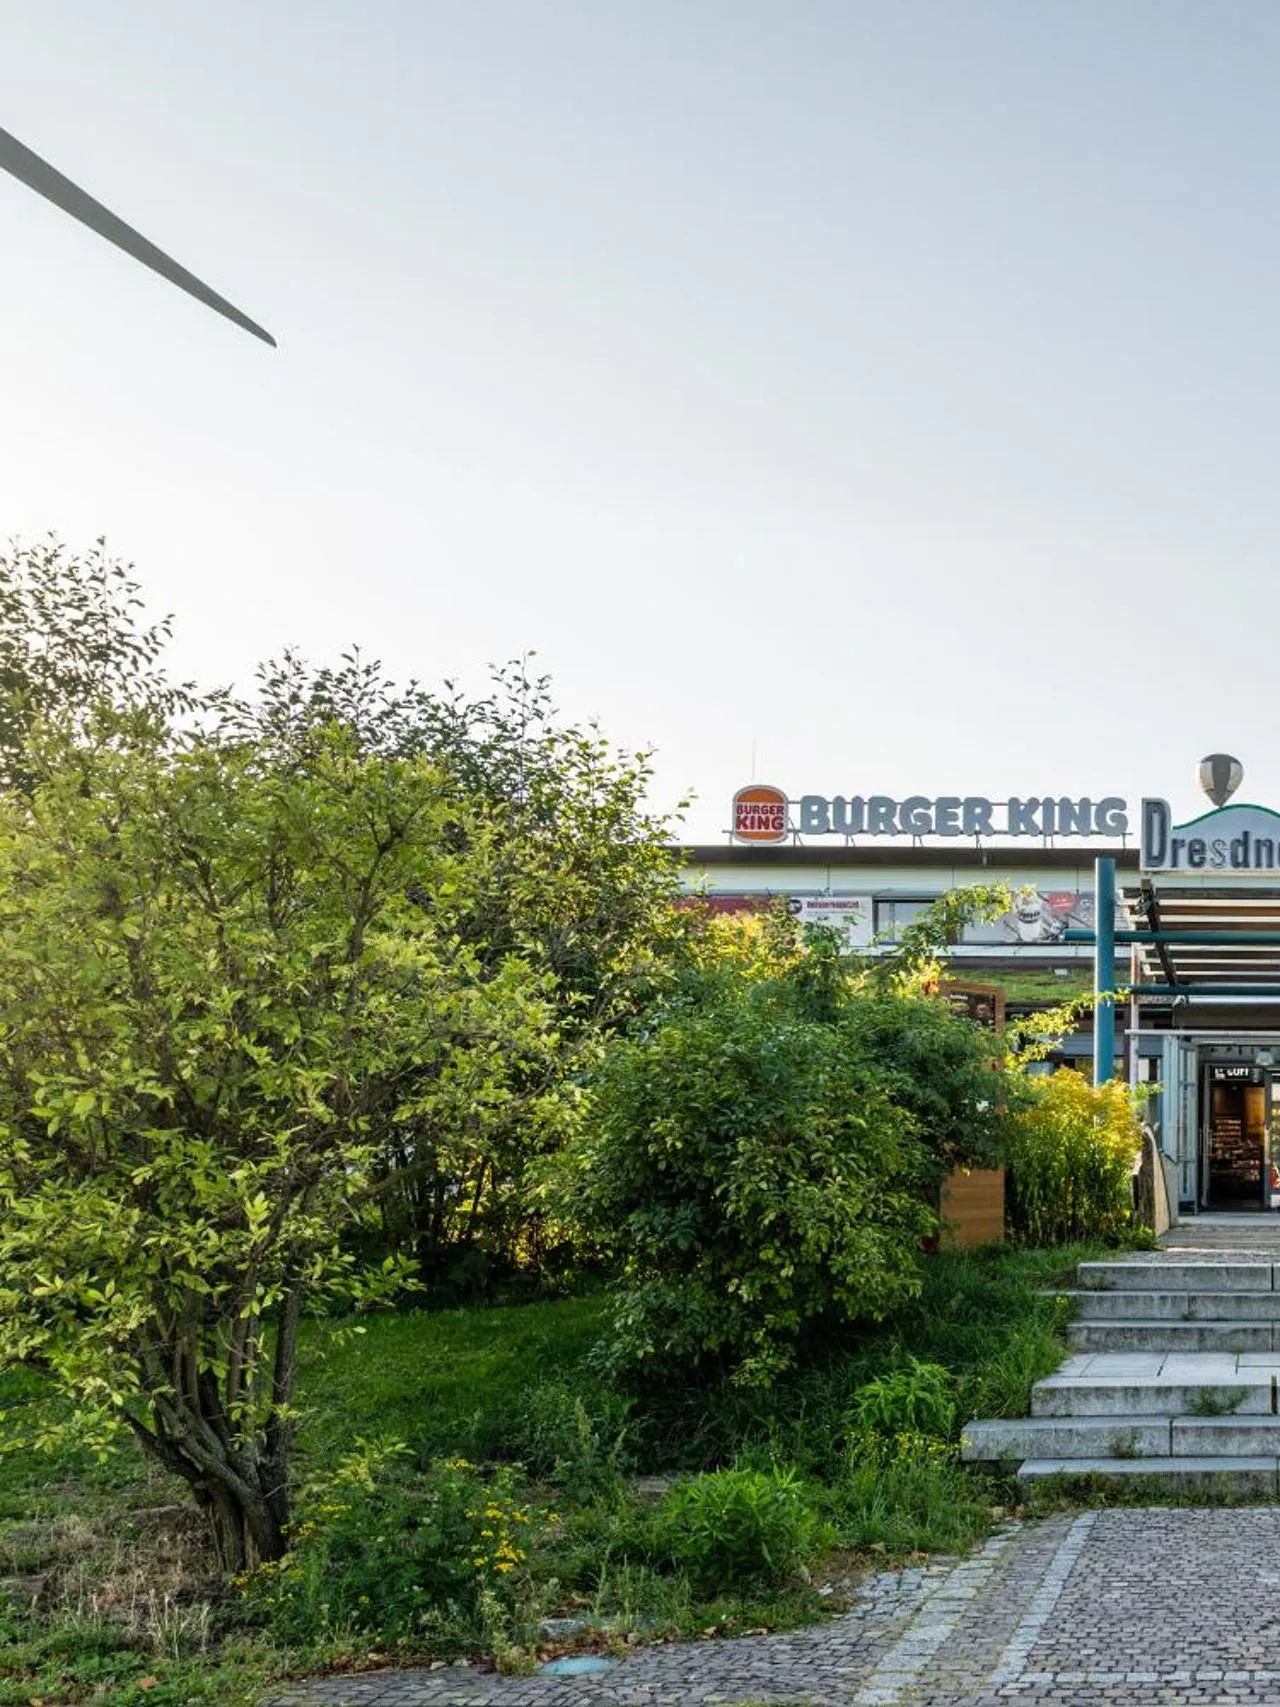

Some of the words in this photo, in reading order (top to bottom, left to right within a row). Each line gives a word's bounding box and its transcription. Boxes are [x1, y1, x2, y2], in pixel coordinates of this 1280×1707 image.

[736, 804, 785, 815] BURGER
[800, 795, 994, 836] BURGER
[1007, 797, 1128, 836] KING
[736, 815, 785, 830] KING
